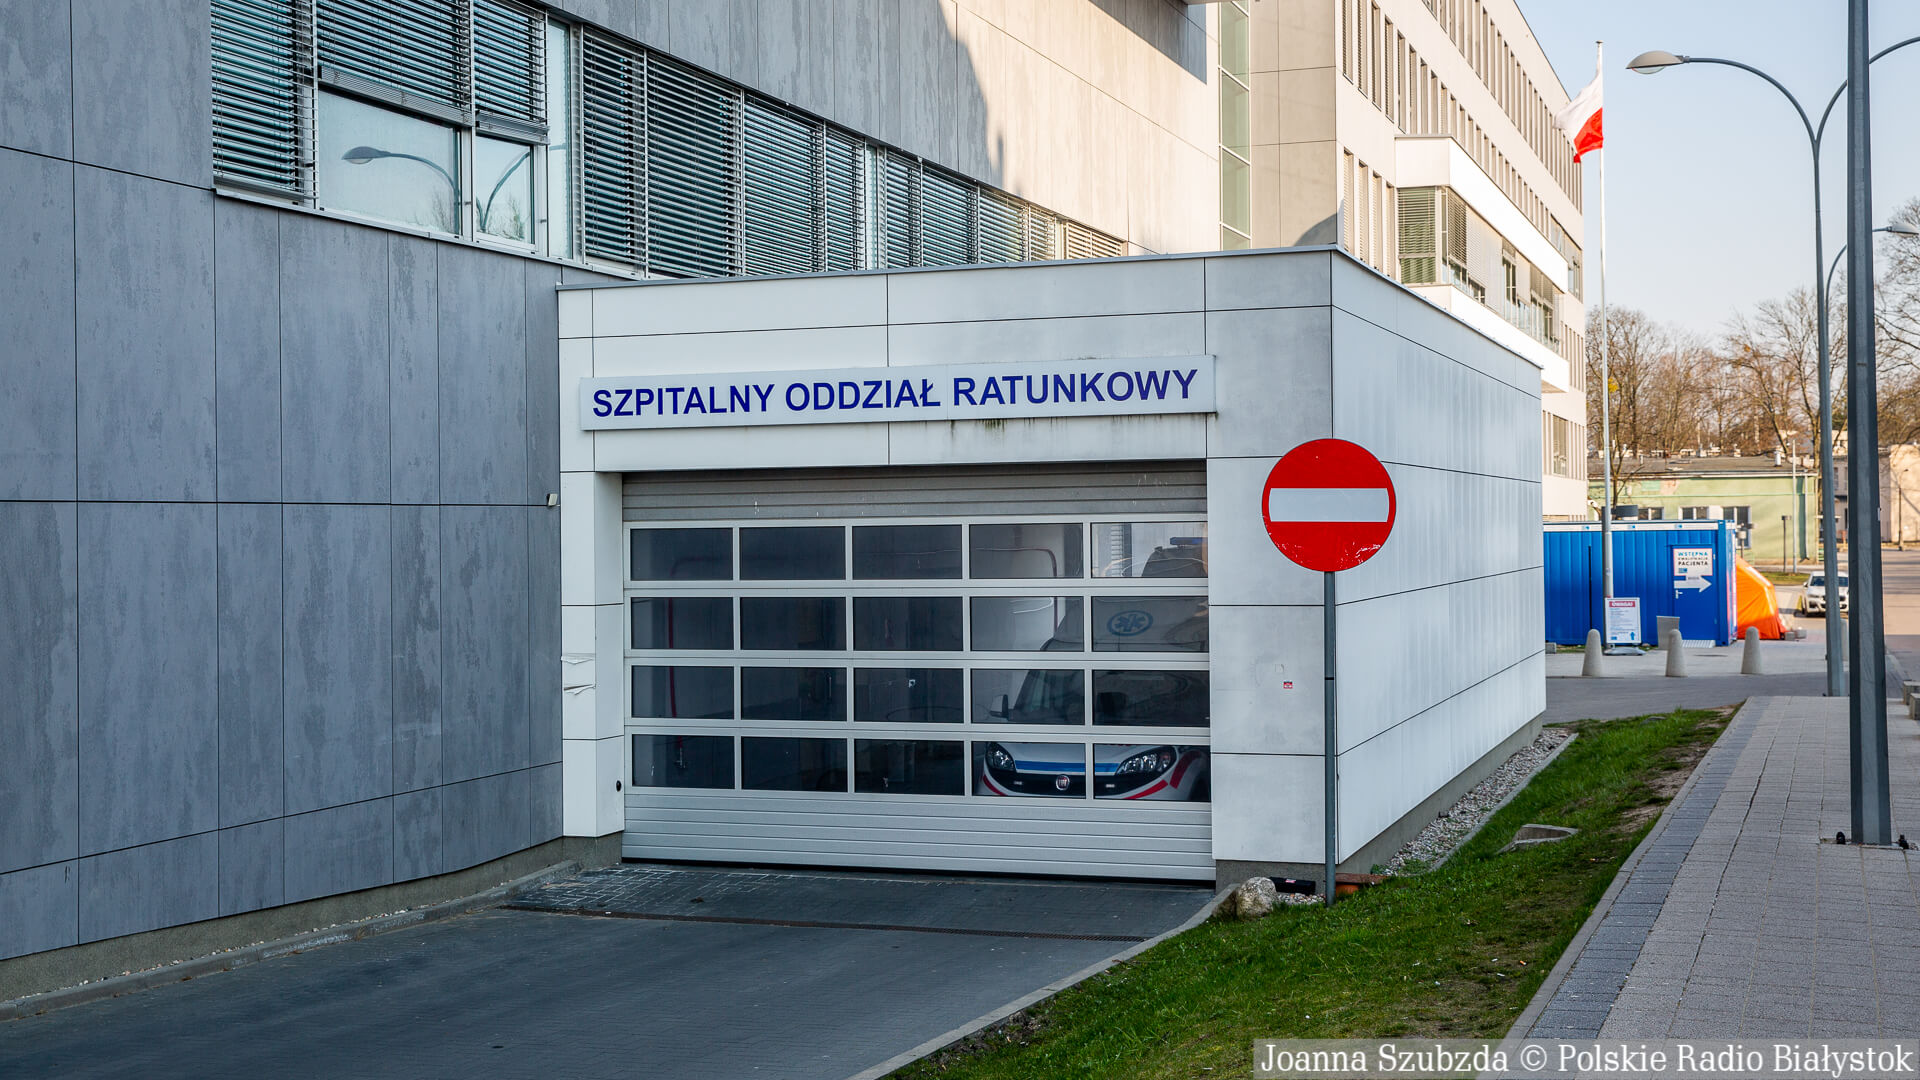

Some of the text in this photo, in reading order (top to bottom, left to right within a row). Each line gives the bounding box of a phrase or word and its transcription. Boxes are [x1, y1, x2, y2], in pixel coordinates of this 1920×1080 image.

[593, 370, 1196, 417] SZPITALNY ODDZIAŁ RATUNKOWY
